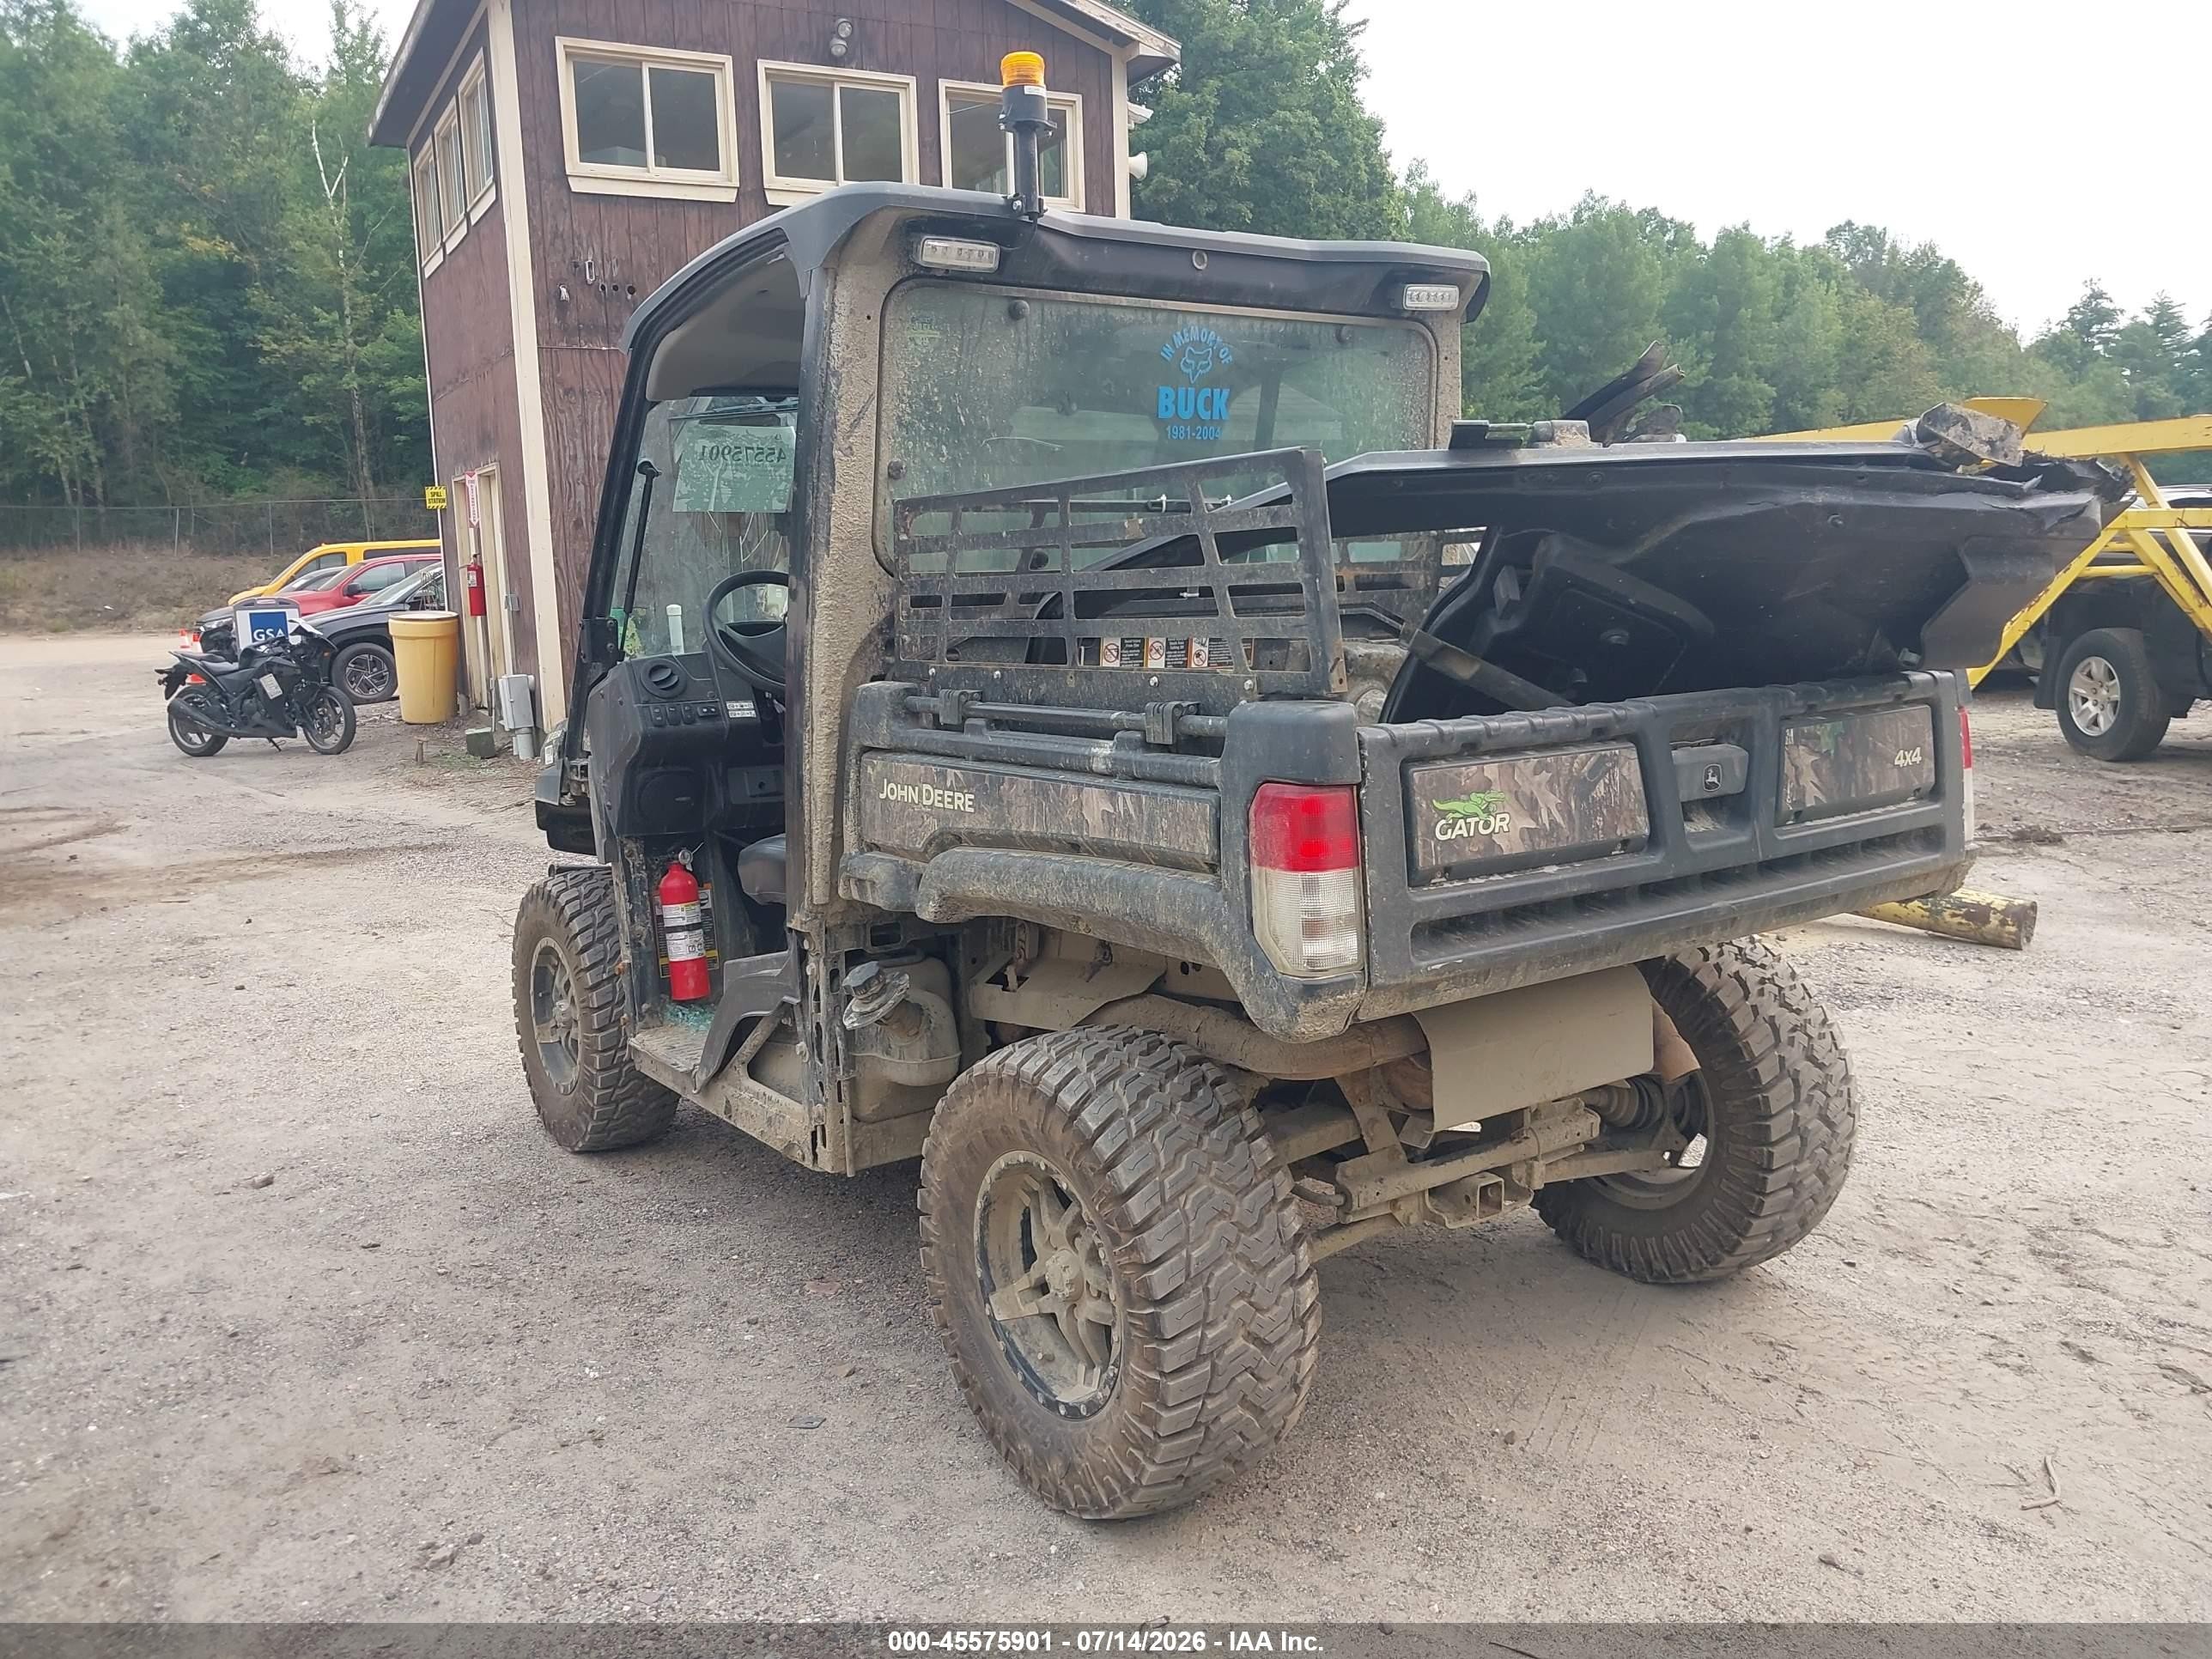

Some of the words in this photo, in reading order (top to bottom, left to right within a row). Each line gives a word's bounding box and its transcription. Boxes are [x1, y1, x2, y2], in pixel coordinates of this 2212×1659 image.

[1160, 344, 1176, 362] IN
[1173, 325, 1223, 350] MEMORY
[1218, 346, 1233, 365] OF
[1158, 386, 1231, 421] BUCK
[253, 629, 284, 641] GSA
[878, 778, 919, 805] JOHN
[922, 783, 975, 813] DEERE
[1435, 812, 1510, 842] GATOR
